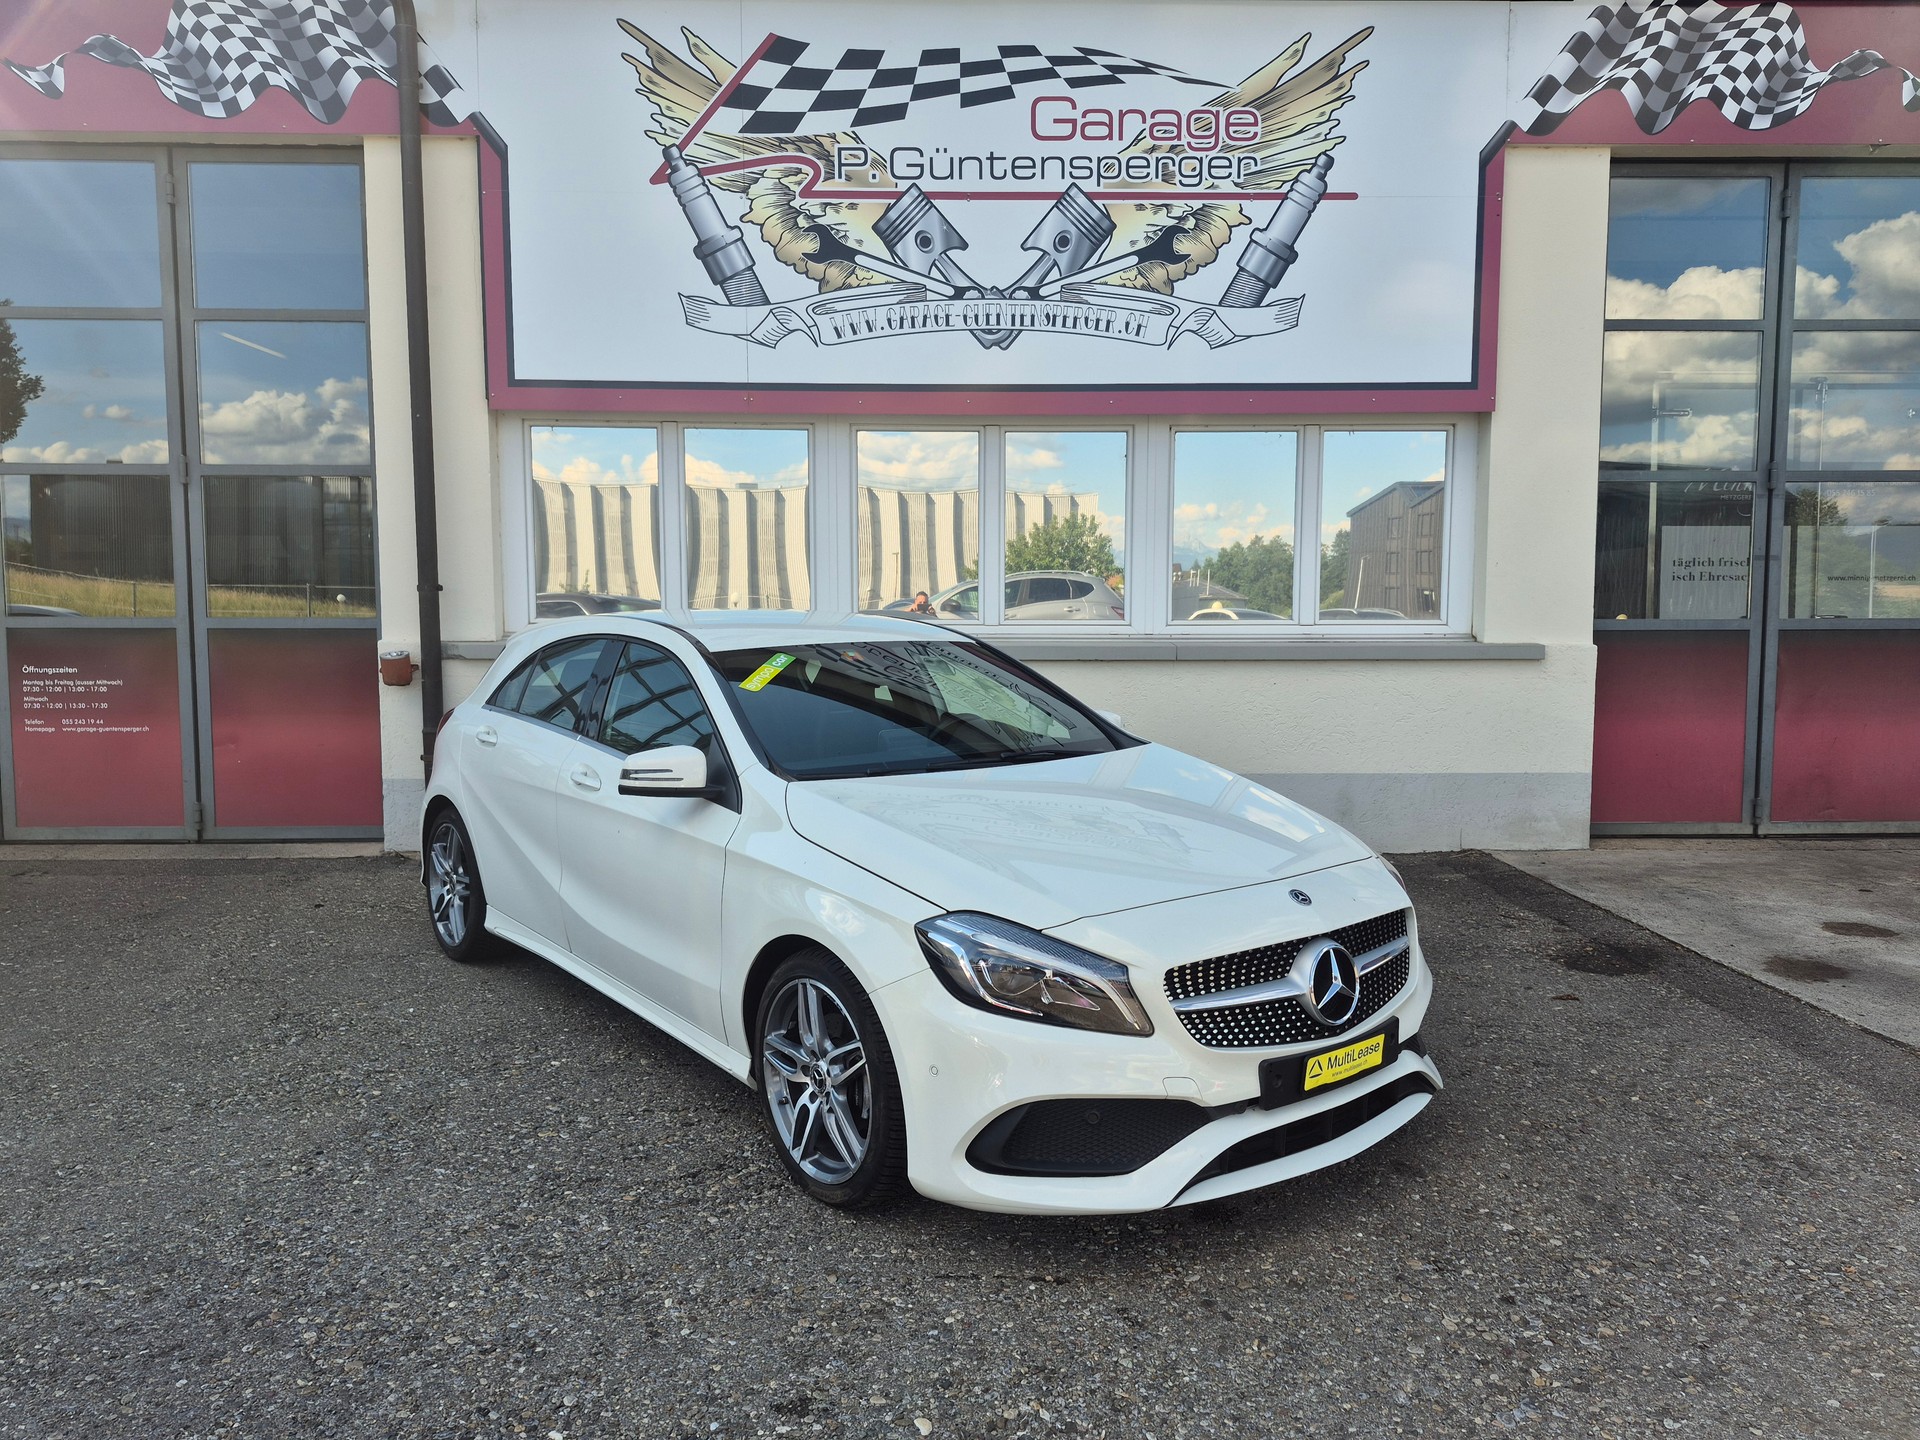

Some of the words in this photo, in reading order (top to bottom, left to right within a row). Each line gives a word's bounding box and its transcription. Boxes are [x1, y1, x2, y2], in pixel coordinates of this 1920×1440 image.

[1029, 95, 1260, 152] Garage
[837, 147, 878, 180] P.
[889, 147, 1258, 187] Güntensperger
[828, 303, 1150, 340] WWW.GARAGE-GUENTENSPERGER.CH
[1672, 557, 1714, 570] täglich
[1672, 572, 1695, 581] isch
[1699, 572, 1747, 581] Ehresac
[1827, 574, 1917, 582] www.minnigmetzgerei.ch
[22, 664, 77, 675] Öffnungszeiten
[1327, 1042, 1380, 1070] MultiLease
